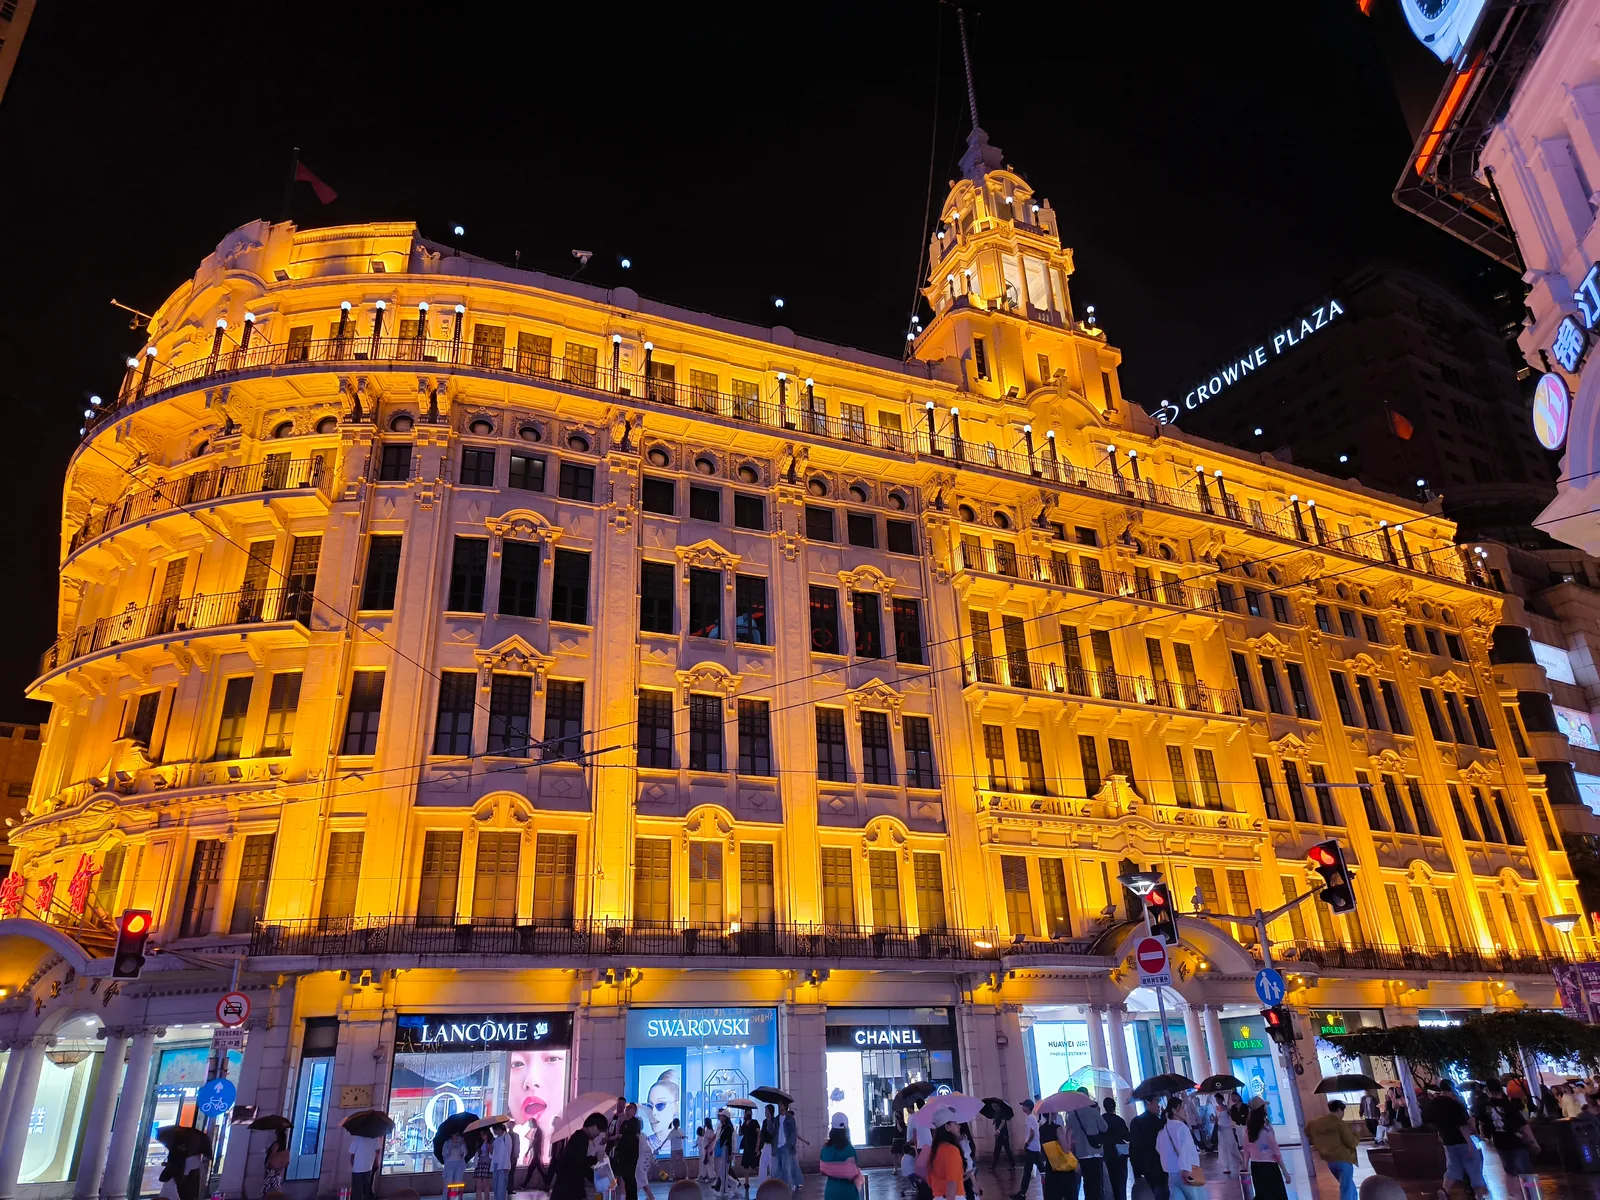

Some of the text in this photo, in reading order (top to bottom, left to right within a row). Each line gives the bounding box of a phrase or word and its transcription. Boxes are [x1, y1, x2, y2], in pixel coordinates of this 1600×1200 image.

[1552, 266, 1600, 373] 锦江
[1185, 300, 1344, 410] CROWNE PLAZA
[420, 1020, 528, 1043] LANCÔME
[647, 1018, 750, 1037] SWAROVSKI
[1321, 1025, 1346, 1035] ROLEX
[855, 1030, 922, 1045] CHANEL
[1048, 1040, 1075, 1048] HUAWEI
[1233, 1039, 1264, 1049] ROLEX
